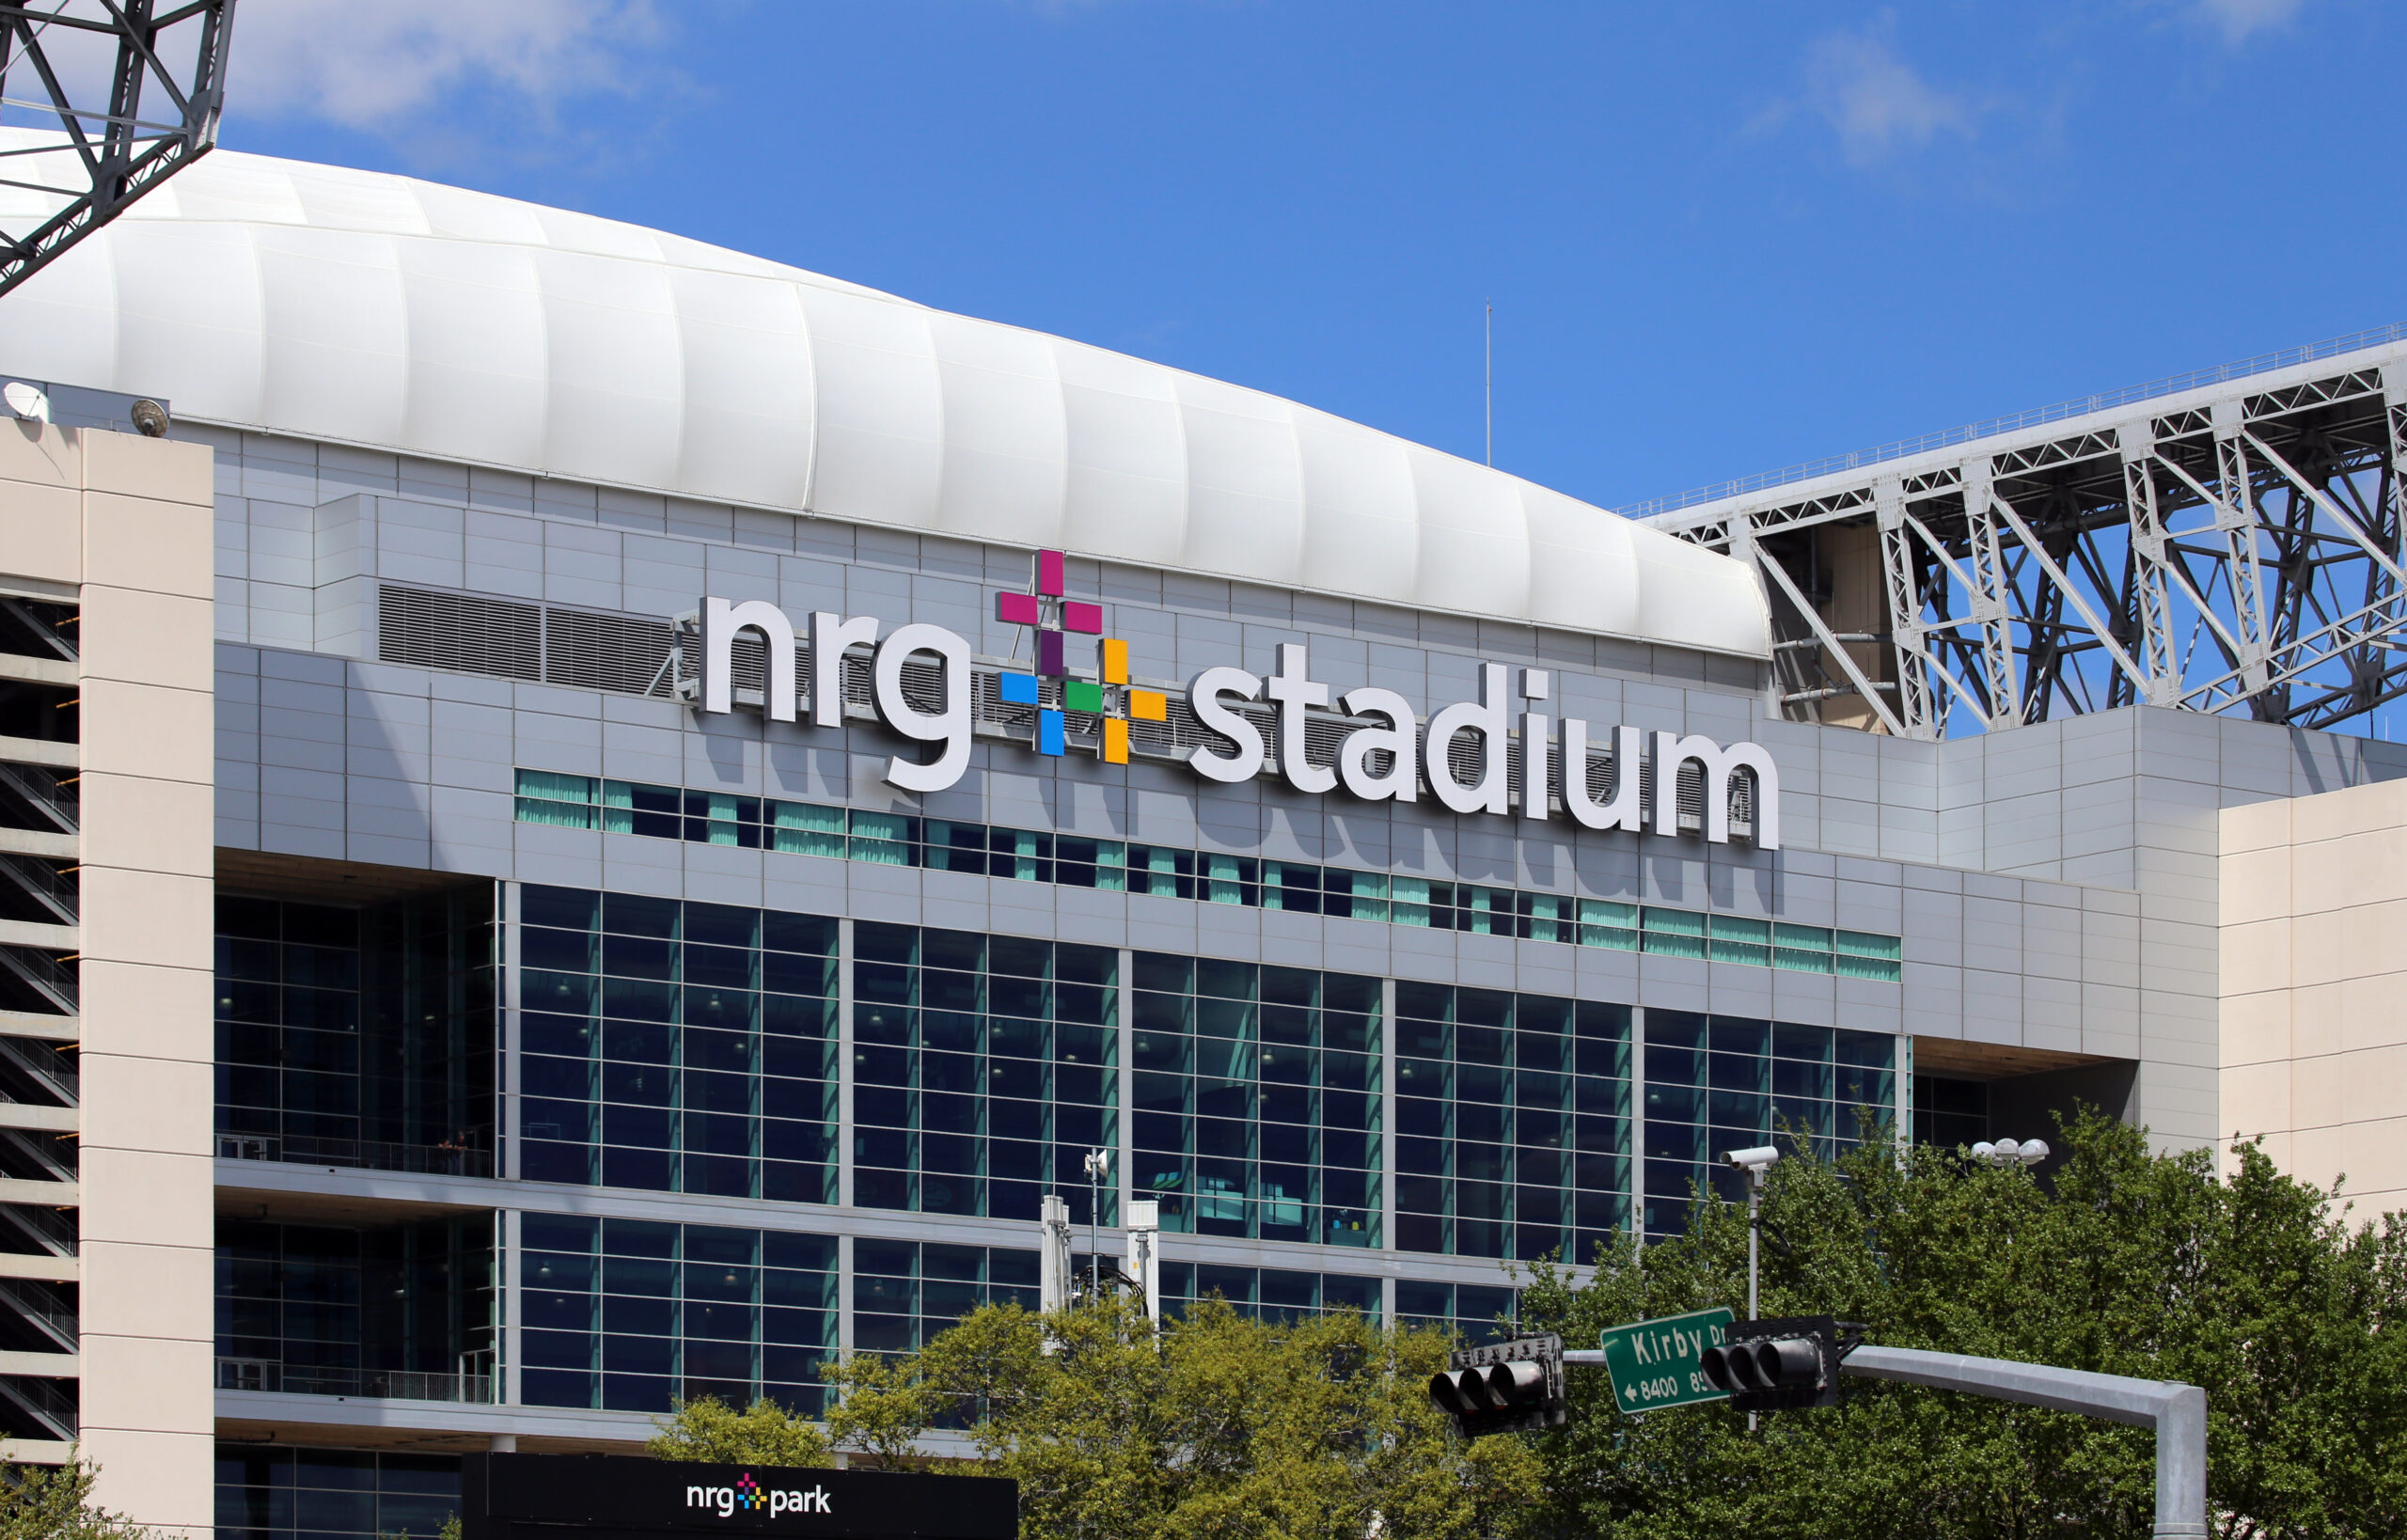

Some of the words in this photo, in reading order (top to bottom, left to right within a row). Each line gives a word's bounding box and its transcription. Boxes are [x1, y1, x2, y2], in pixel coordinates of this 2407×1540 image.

[700, 596, 971, 792] nrg
[1186, 643, 1779, 850] stadium
[1631, 1327, 1703, 1365] Kirby
[1640, 1375, 1678, 1401] 8400
[686, 1485, 734, 1517] nrg
[770, 1485, 832, 1518] park
